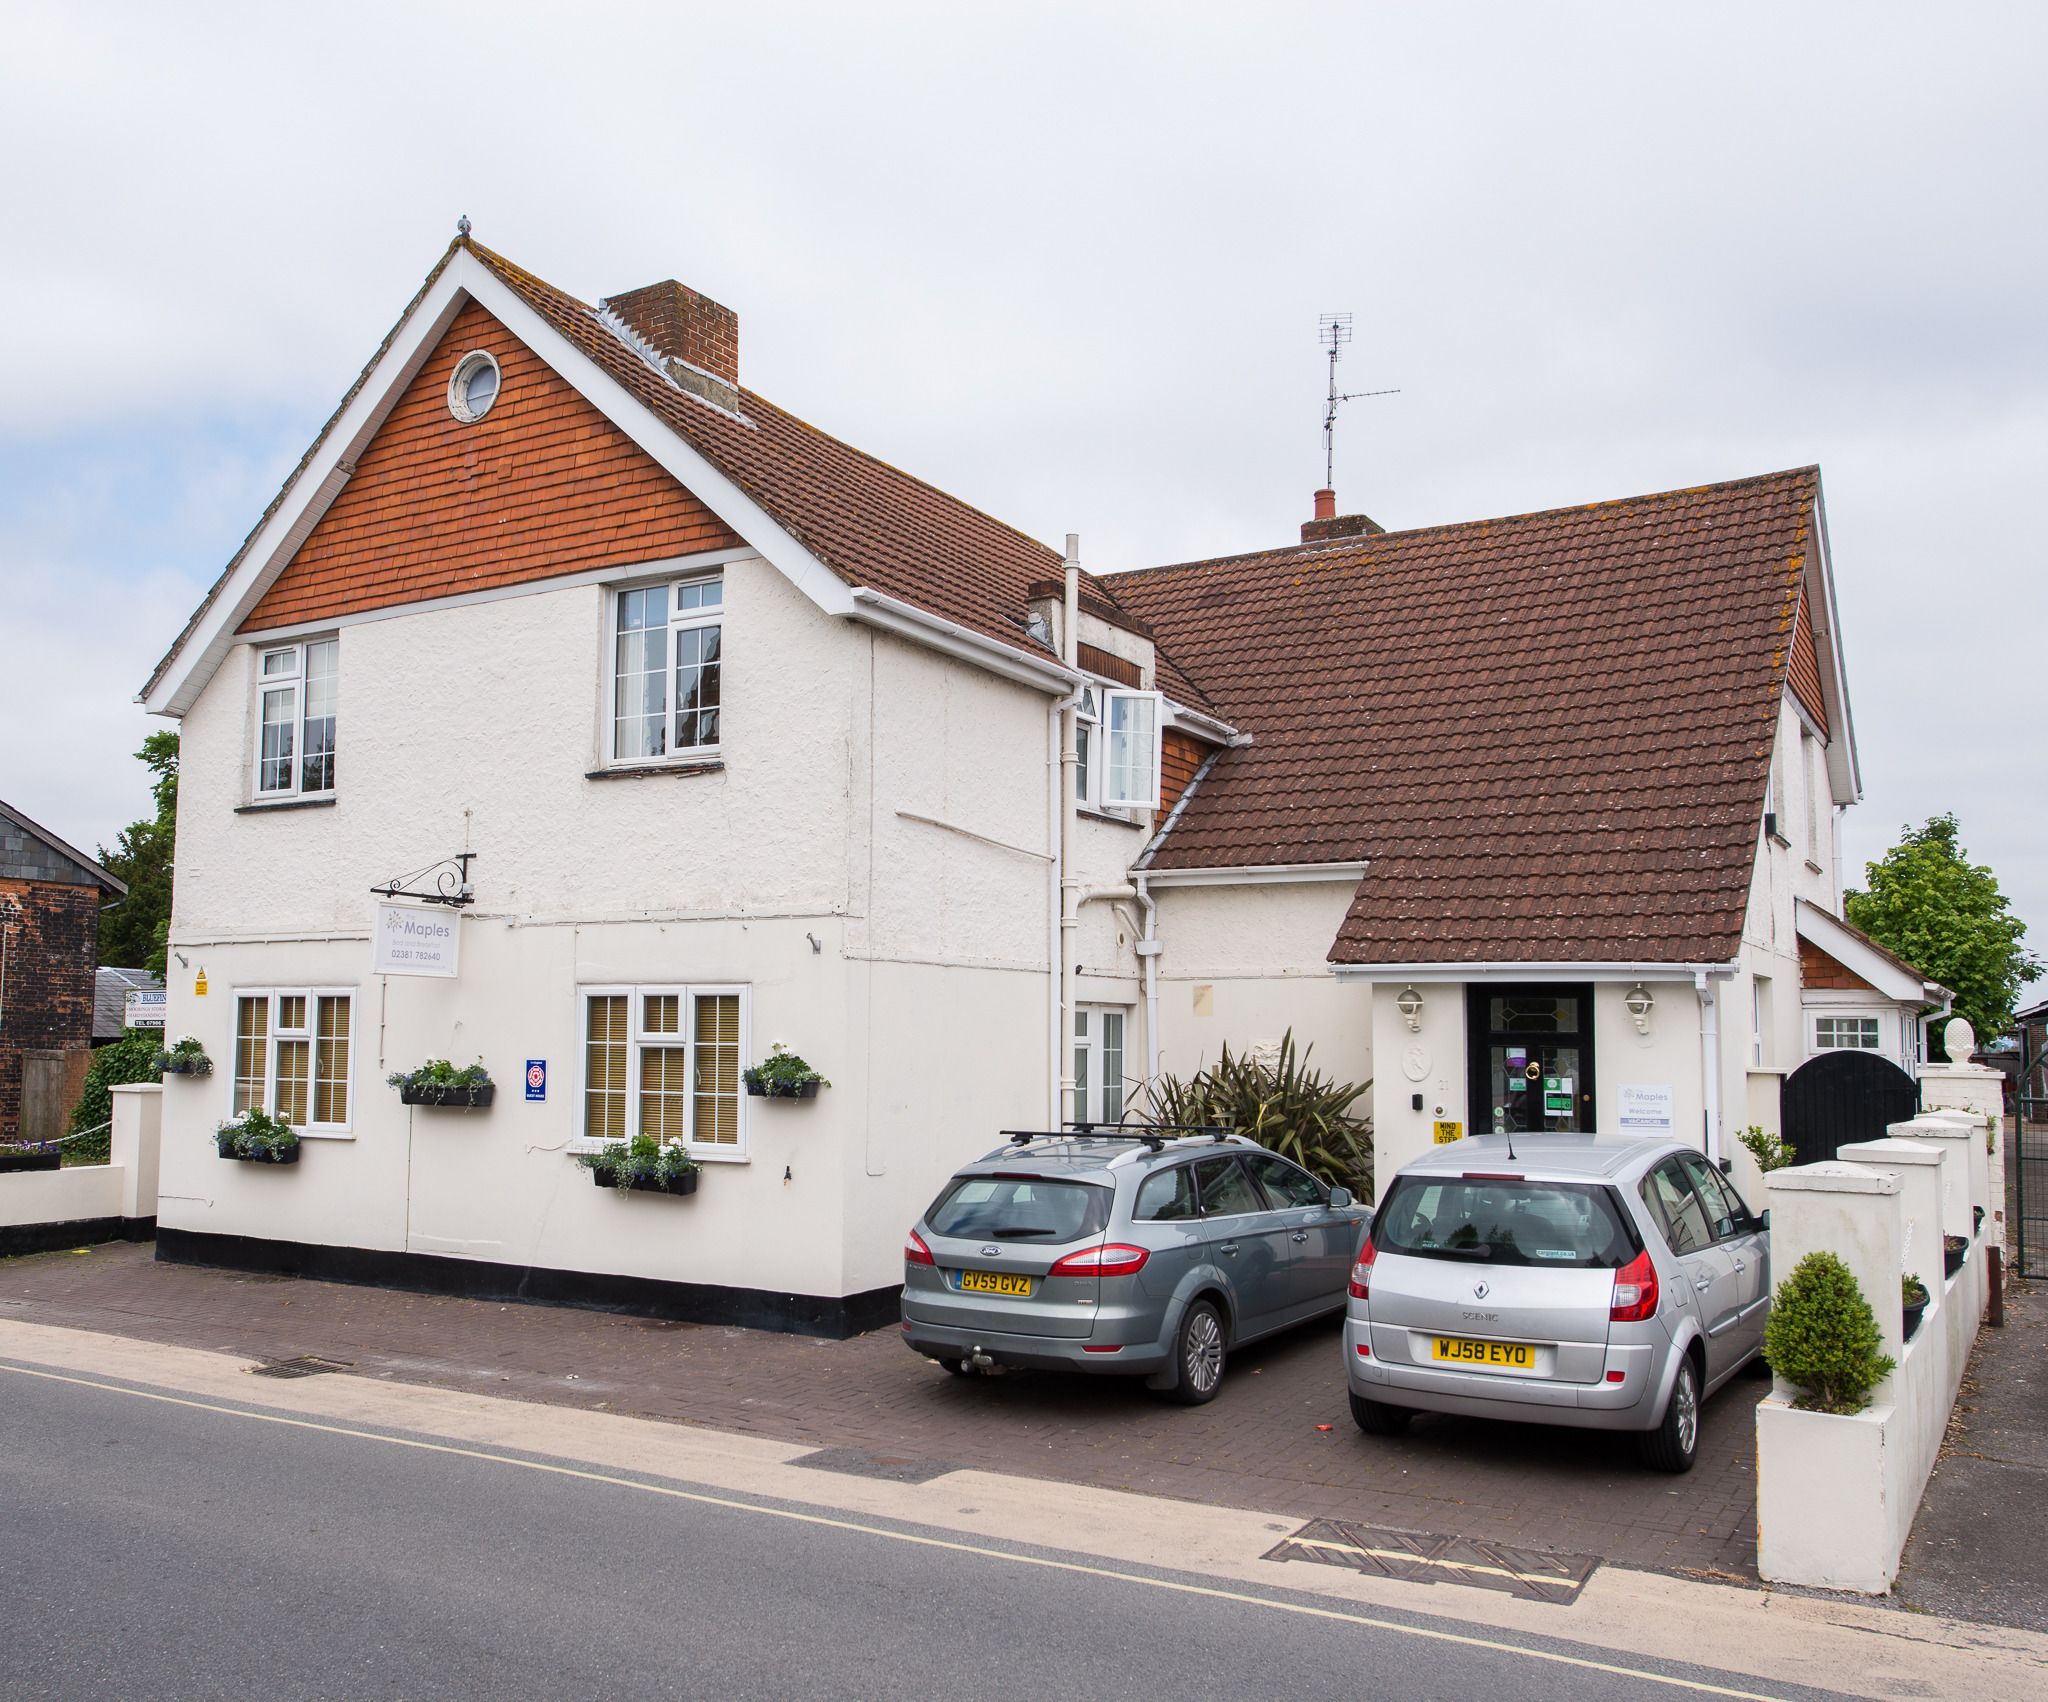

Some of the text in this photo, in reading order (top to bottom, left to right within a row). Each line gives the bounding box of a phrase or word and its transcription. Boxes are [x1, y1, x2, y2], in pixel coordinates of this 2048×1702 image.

[404, 921, 450, 939] Maples
[1635, 1092, 1669, 1101] Maples
[1440, 1122, 1456, 1130] MIND
[1441, 1129, 1455, 1137] THE
[963, 1271, 1028, 1293] GV59 GVZ
[1462, 1311, 1499, 1322] SCENIC
[1439, 1340, 1526, 1364] WJ58 EYO
